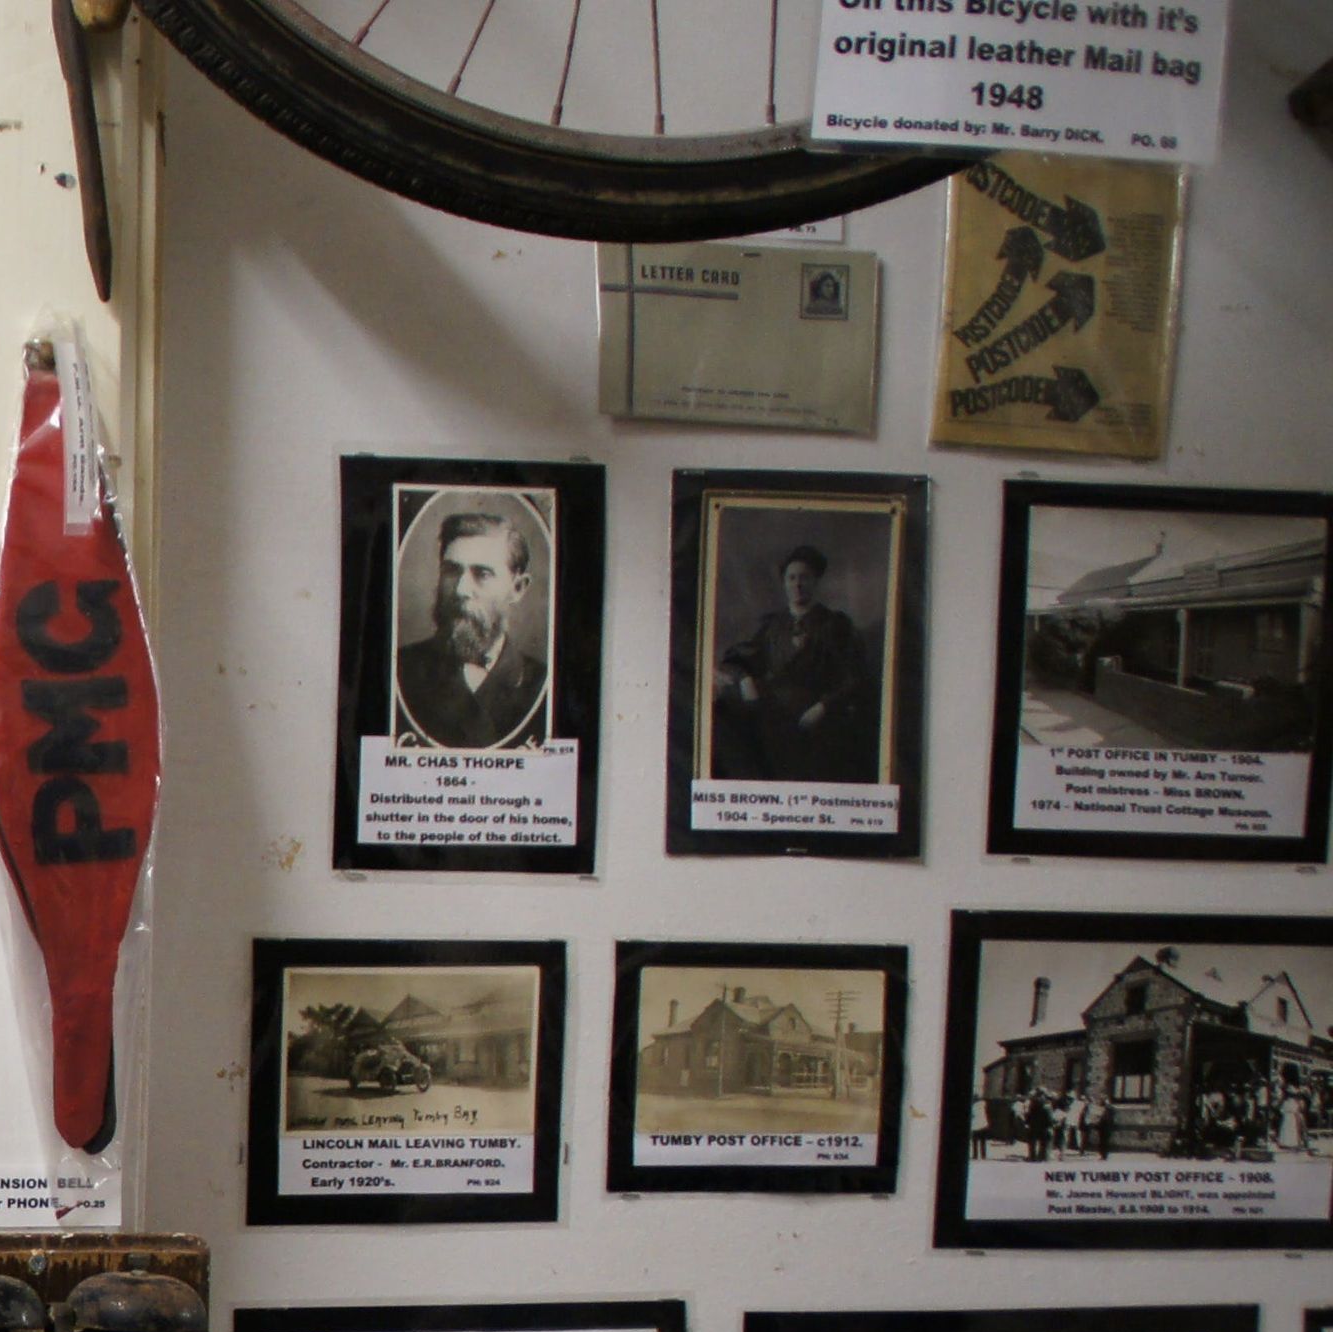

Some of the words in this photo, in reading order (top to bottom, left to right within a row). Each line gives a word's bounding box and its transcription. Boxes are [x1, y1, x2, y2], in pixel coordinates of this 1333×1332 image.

[965, 0, 1078, 24] Bicycle
[1088, 4, 1148, 28] with
[1157, 8, 1199, 34] it's
[834, 32, 956, 63] original
[968, 36, 1076, 67] leather
[1084, 45, 1142, 73] Mail
[1152, 52, 1201, 85] bag
[971, 83, 1044, 110] 1948
[827, 115, 887, 131] Bicycle
[893, 118, 959, 133] donated
[964, 121, 986, 136] by:
[992, 122, 1016, 136] Mr.
[1065, 127, 1104, 143] DICK.
[641, 265, 694, 281] LETTER
[702, 269, 740, 285] CARD
[16, 579, 136, 864] PMG
[385, 756, 412, 768] MR.
[417, 756, 458, 768] CHAS
[464, 758, 525, 769] THORPE
[436, 777, 467, 786] 1864
[370, 794, 443, 804] Distributed
[448, 795, 475, 804] mail
[480, 796, 530, 808] through
[535, 798, 542, 806] a
[365, 813, 414, 823] shutter
[418, 813, 429, 822] in
[433, 814, 454, 823] the
[459, 814, 488, 823] door
[493, 814, 506, 823] of
[509, 814, 528, 824] his
[533, 815, 572, 826] home,
[717, 812, 748, 821] 1904
[762, 813, 814, 824] Spencer
[819, 814, 835, 824] St.
[377, 832, 390, 841] to
[395, 831, 415, 841] the
[420, 832, 463, 844] people
[468, 832, 481, 841] of
[486, 832, 506, 841] the
[510, 832, 562, 842] district.
[303, 1139, 363, 1149] LINCOLN
[368, 1139, 401, 1149] MAIL
[406, 1139, 465, 1149] LEAVING
[470, 1139, 521, 1148] TUMBY.
[651, 1135, 702, 1145] TUMBY
[708, 1135, 746, 1146] POST
[751, 1135, 802, 1146] OFFICE
